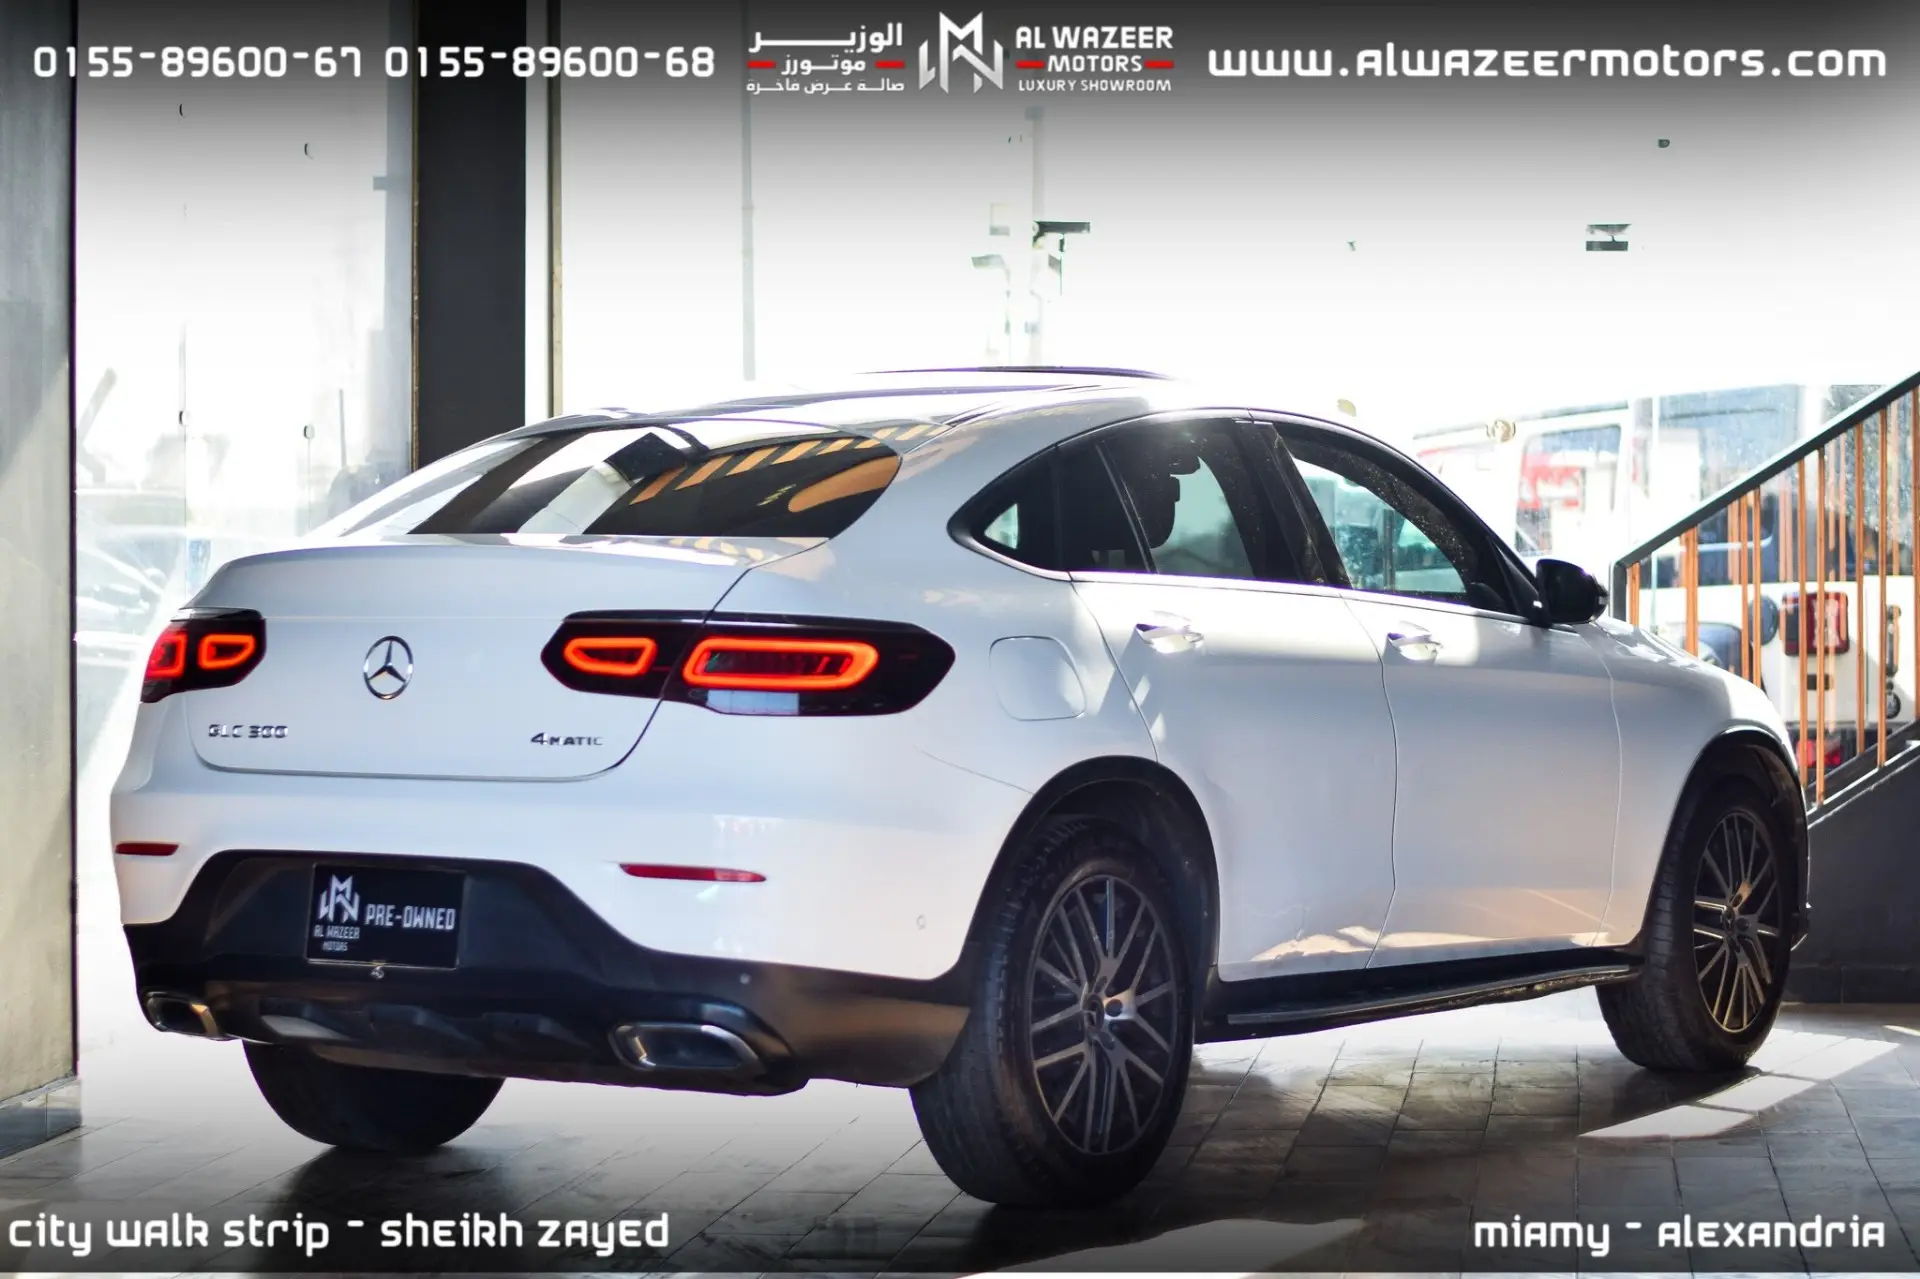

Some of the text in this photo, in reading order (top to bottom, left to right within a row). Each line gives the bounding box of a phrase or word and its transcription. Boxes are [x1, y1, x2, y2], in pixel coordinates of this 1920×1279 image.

[208, 724, 289, 738] GLC 300
[530, 732, 604, 746] 4MATIC
[364, 903, 456, 931] PRE-OWNED
[313, 924, 361, 940] AL WAZEER
[322, 941, 349, 952] MOTORS
